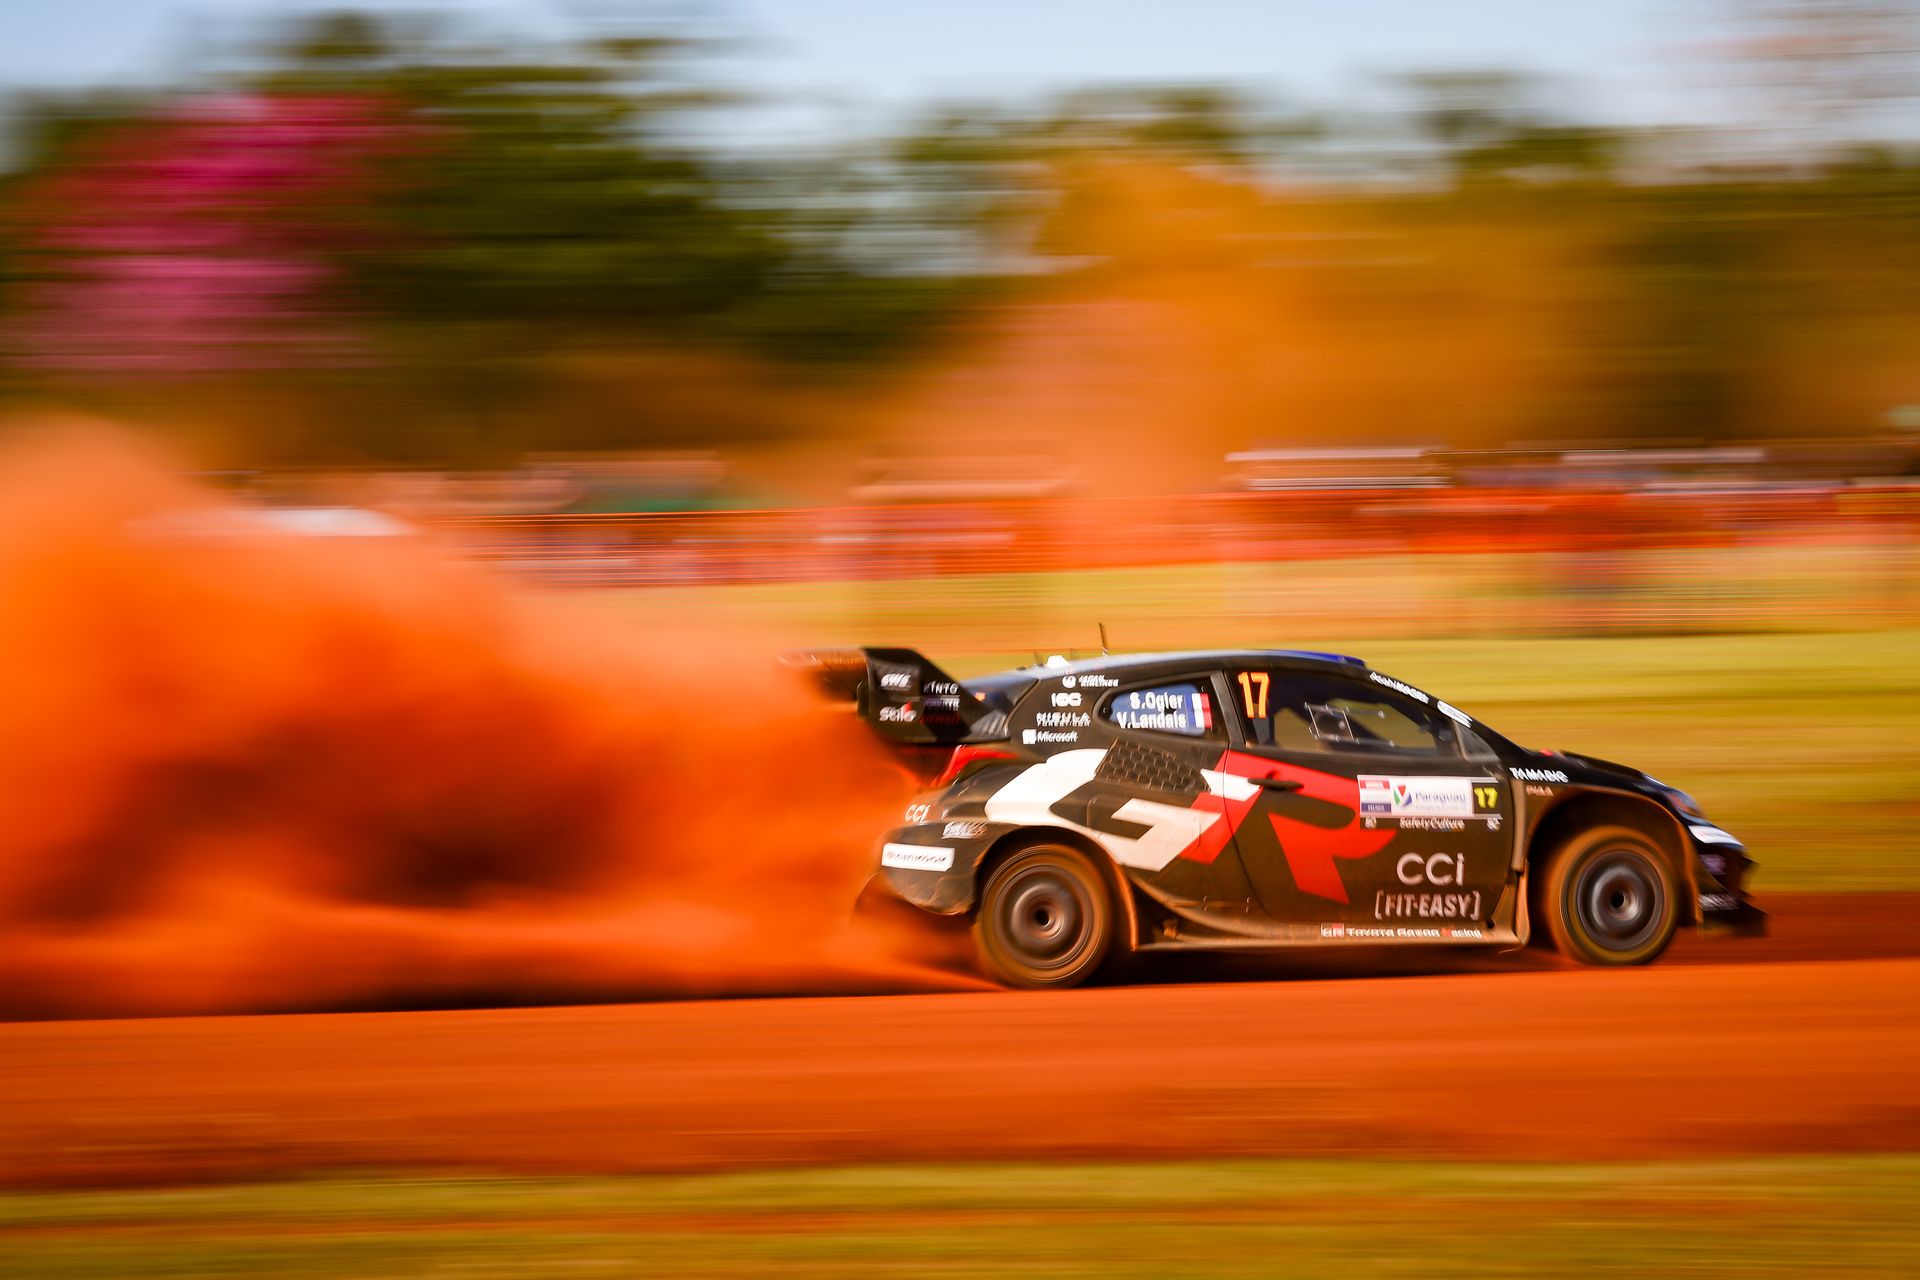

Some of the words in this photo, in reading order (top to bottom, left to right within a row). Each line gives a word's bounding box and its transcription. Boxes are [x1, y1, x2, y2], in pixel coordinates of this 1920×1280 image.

[1130, 691, 1184, 712] S.Ogier
[1238, 671, 1269, 718] 17
[1116, 711, 1187, 729] V.Landais
[1037, 730, 1078, 743] Microsoft
[1415, 791, 1466, 804] Paraguay
[1473, 787, 1498, 808] 17
[1346, 928, 1395, 938] TOYOTA
[1397, 928, 1441, 938] GAZOO
